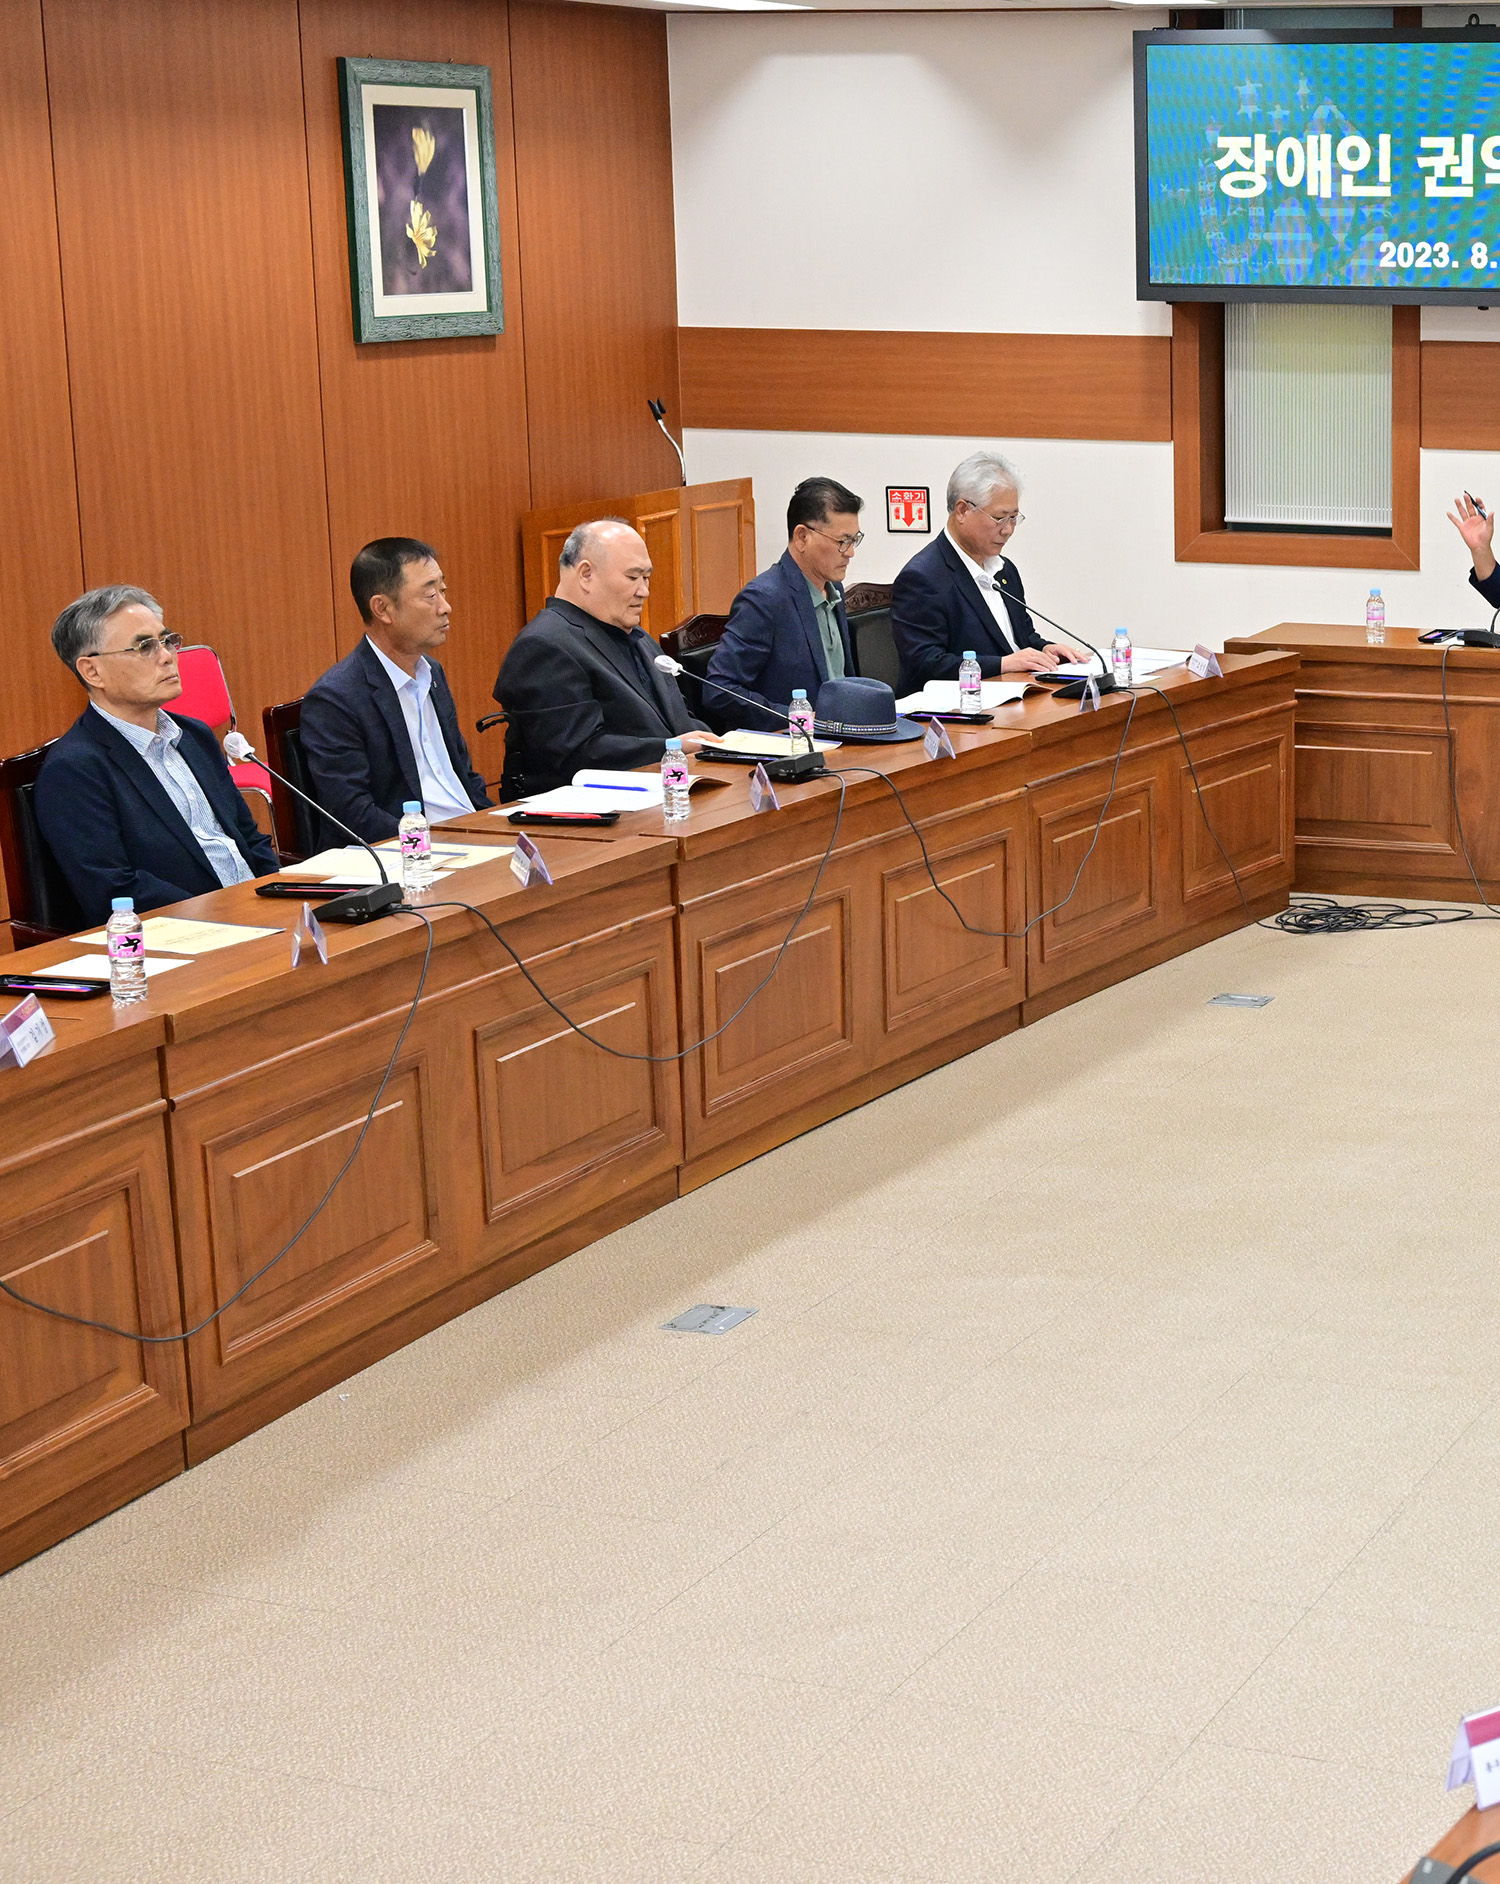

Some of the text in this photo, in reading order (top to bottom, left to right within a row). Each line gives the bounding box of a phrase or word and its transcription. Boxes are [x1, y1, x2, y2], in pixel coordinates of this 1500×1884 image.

[1213, 133, 1392, 199] 장애인
[1379, 241, 1459, 269] 2023.
[1470, 241, 1498, 270] 8.
[892, 491, 924, 500] 소화기
